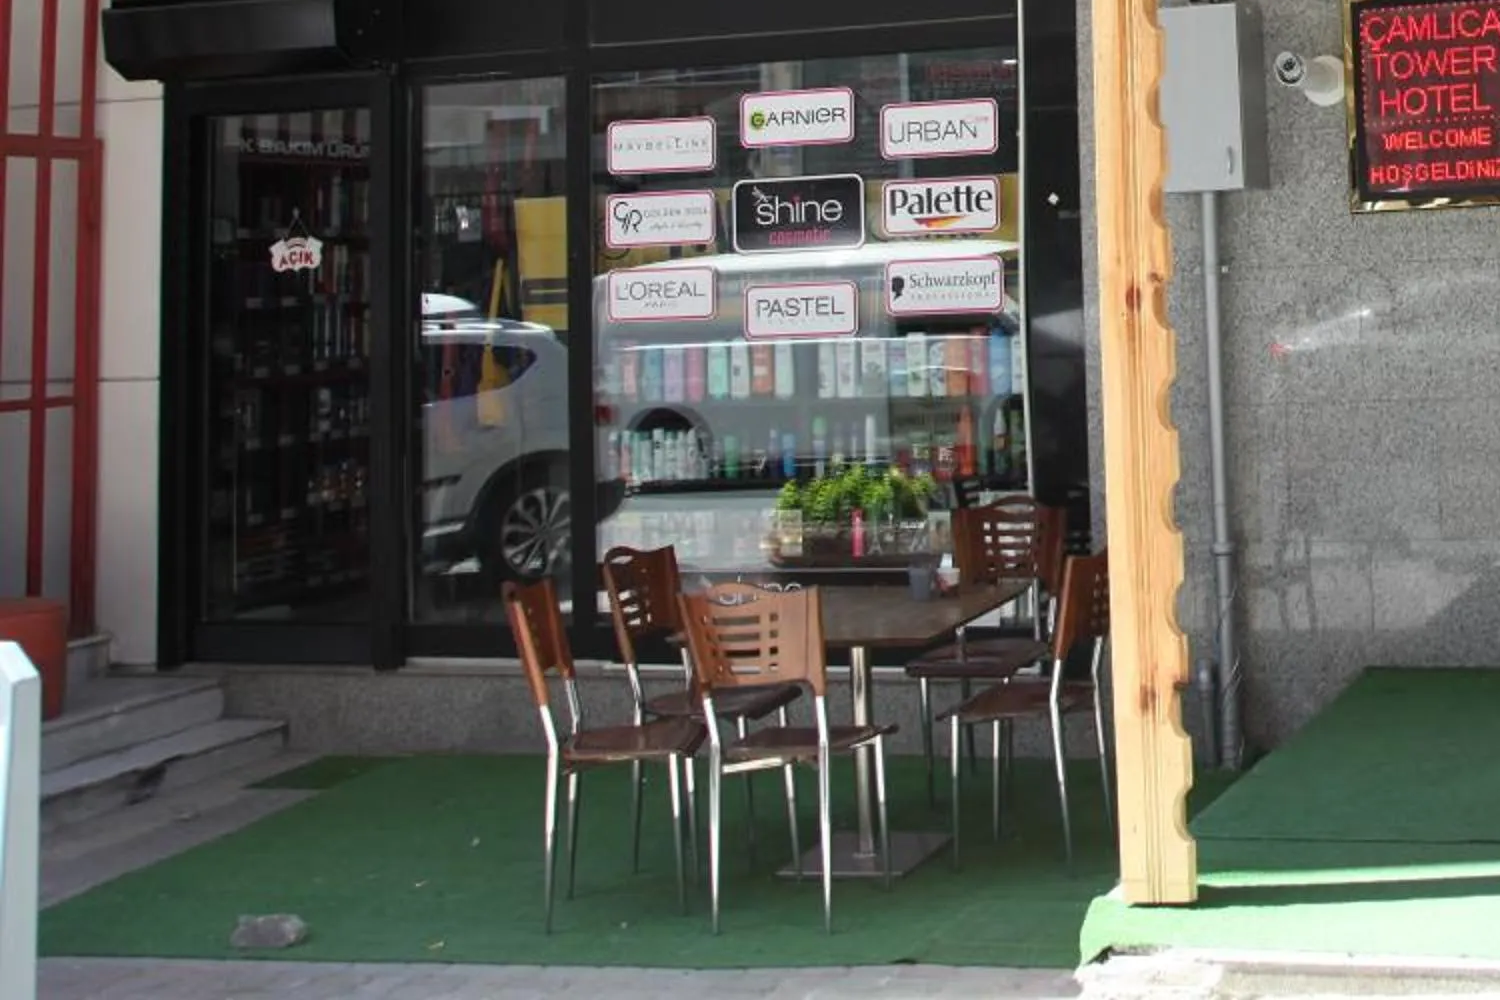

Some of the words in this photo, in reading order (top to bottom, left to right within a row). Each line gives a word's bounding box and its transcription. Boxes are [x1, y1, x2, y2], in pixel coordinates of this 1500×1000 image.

[1370, 44, 1497, 80] TOWER
[1381, 83, 1491, 117] HOTEL
[889, 119, 978, 144] URBAN
[1382, 126, 1492, 150] WELCOME
[756, 195, 843, 225] shine
[889, 185, 993, 216] Palette
[909, 269, 998, 290] Schwarzkopf
[756, 296, 845, 318] PASTEL
